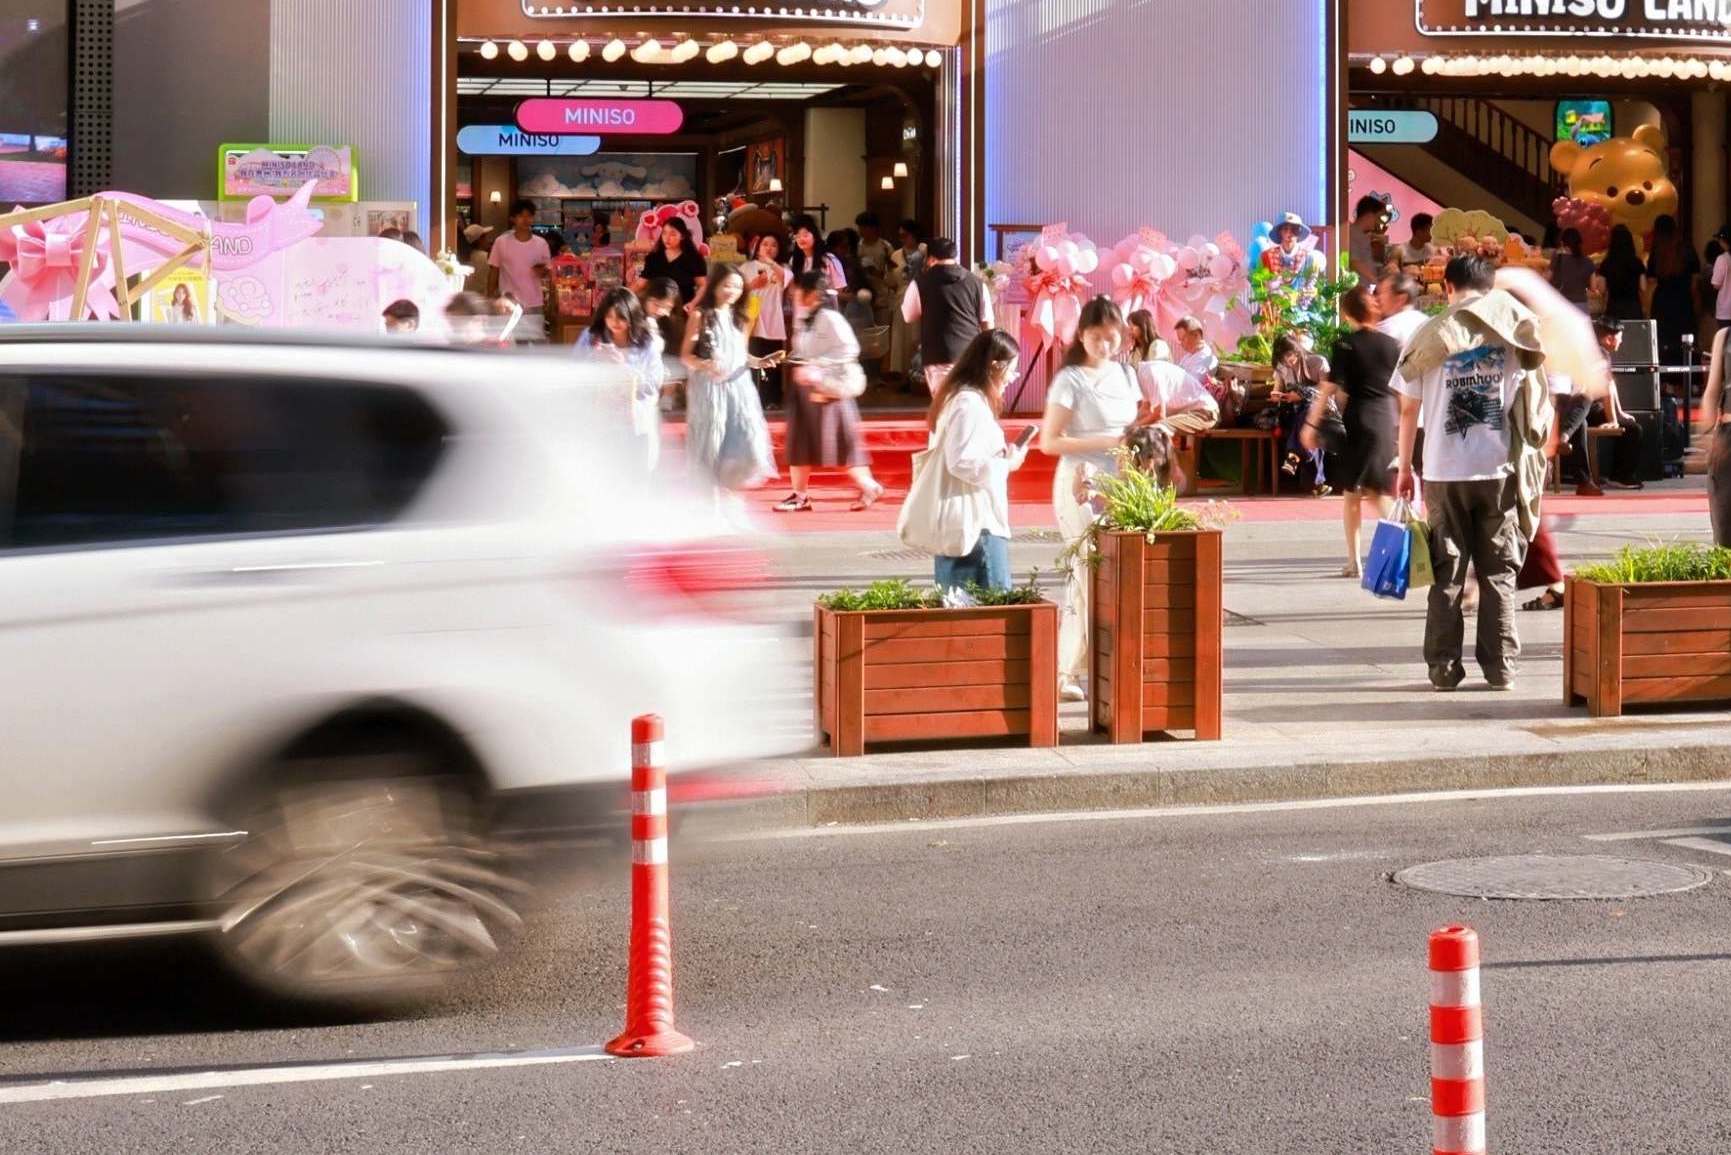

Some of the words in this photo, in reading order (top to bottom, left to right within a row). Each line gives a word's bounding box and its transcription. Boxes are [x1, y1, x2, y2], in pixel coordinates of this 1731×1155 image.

[565, 107, 636, 125] MINISO
[1350, 119, 1396, 134] INISO
[498, 132, 560, 147] MINISO
[209, 236, 253, 255] AND
